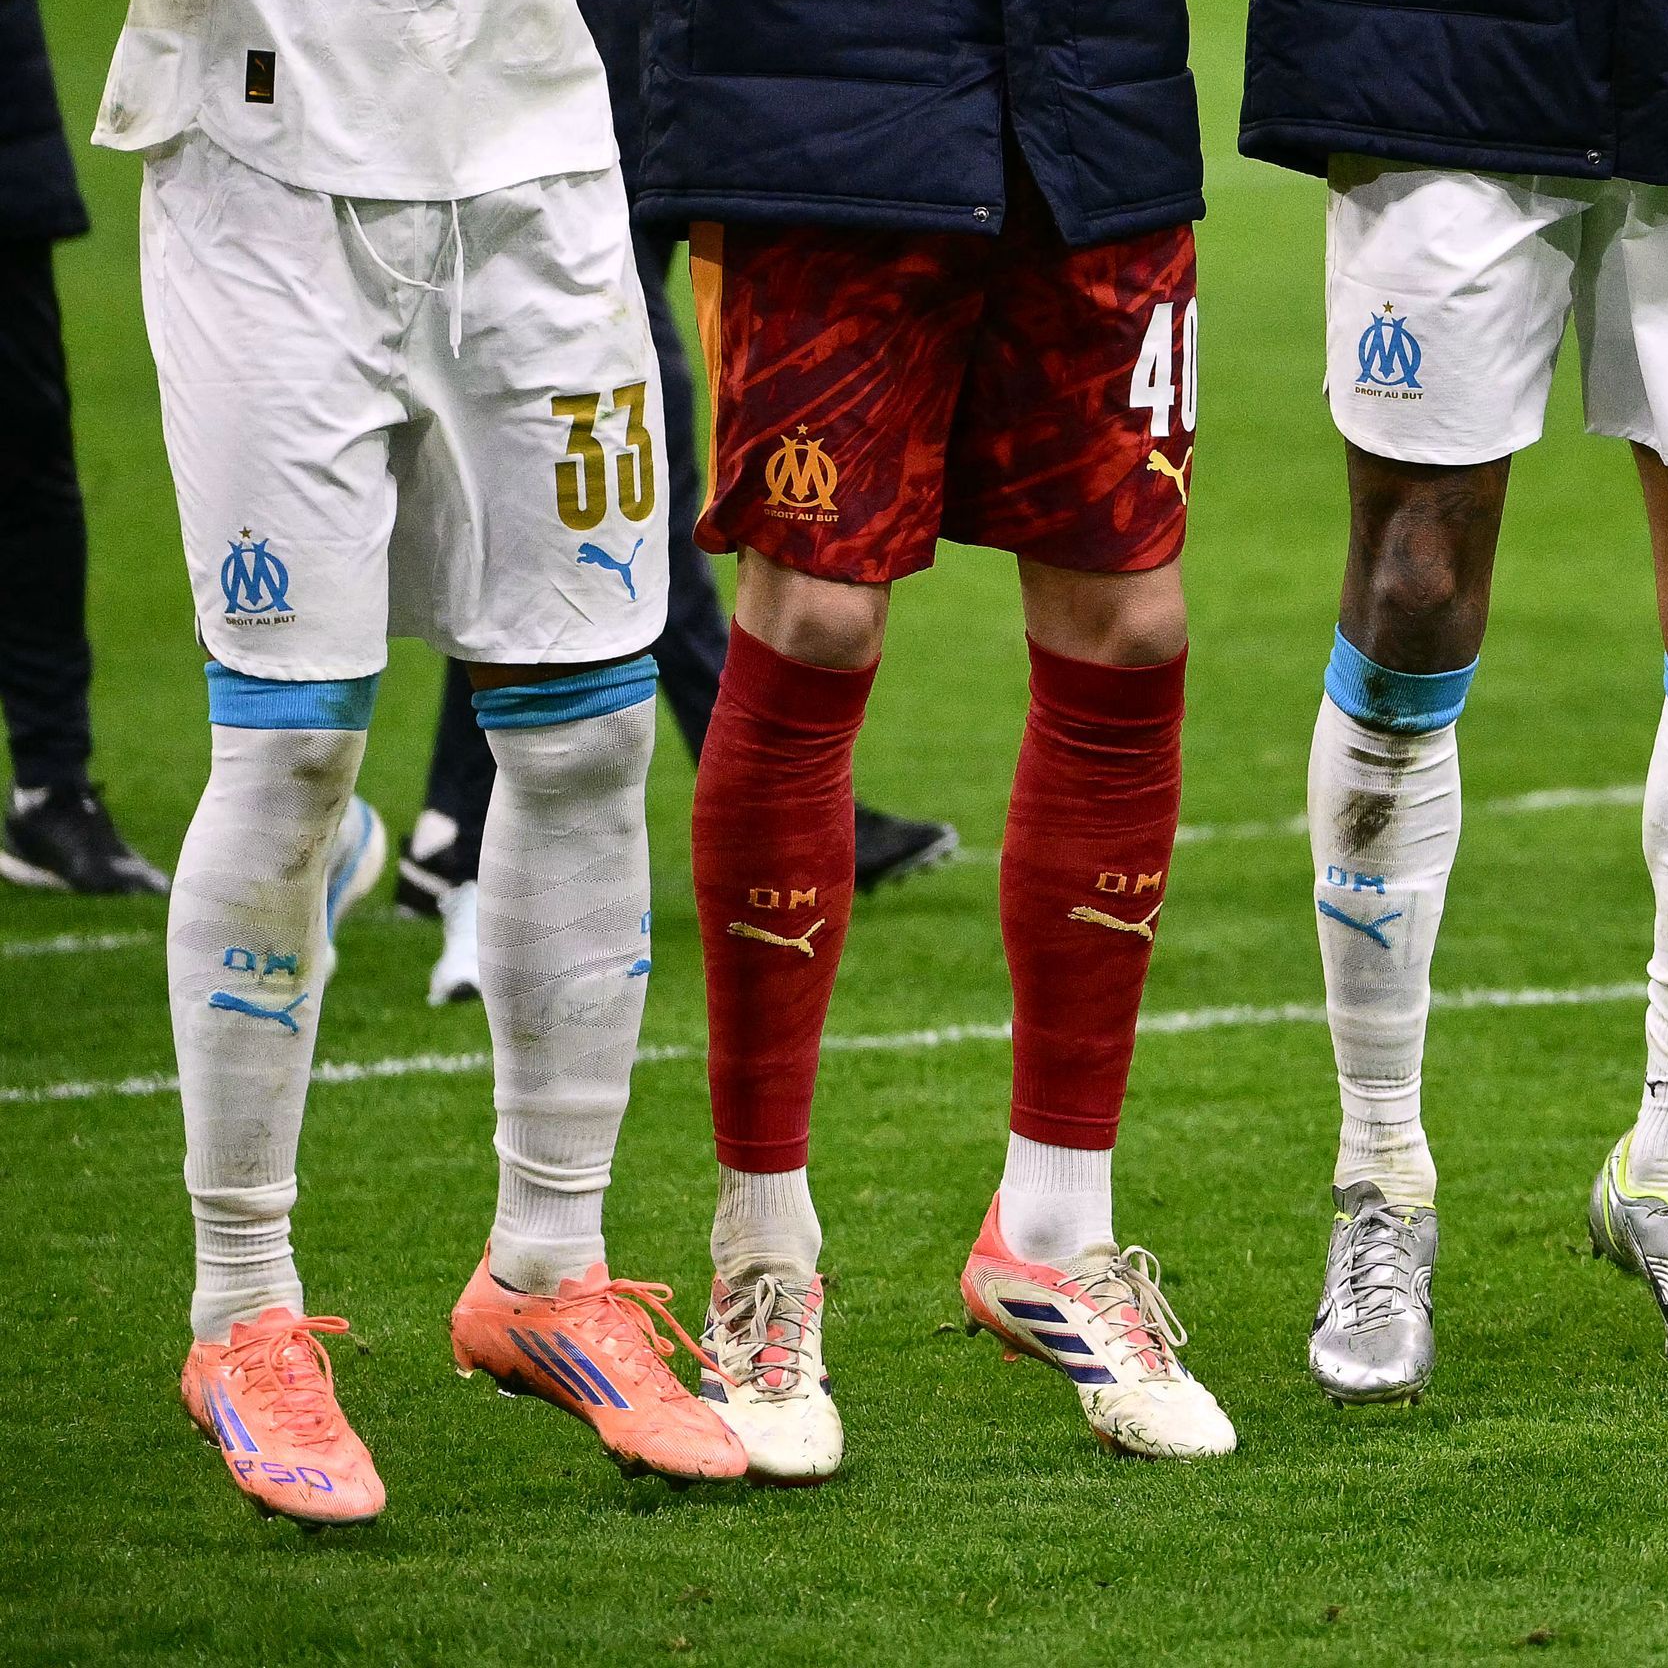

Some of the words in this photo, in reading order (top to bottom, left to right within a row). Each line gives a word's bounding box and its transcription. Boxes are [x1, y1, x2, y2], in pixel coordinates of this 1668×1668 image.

[1129, 296, 1198, 437] 40
[1355, 386, 1382, 398] DROIT
[1384, 391, 1398, 399] AU
[1402, 392, 1423, 400] BUT
[551, 381, 655, 531] 33
[764, 508, 795, 520] DROIT
[797, 513, 813, 521] AU
[816, 514, 840, 522] BUT
[225, 617, 254, 626] DROIT
[273, 615, 296, 624] BUT
[1096, 869, 1163, 895] OM
[749, 886, 818, 911] OM
